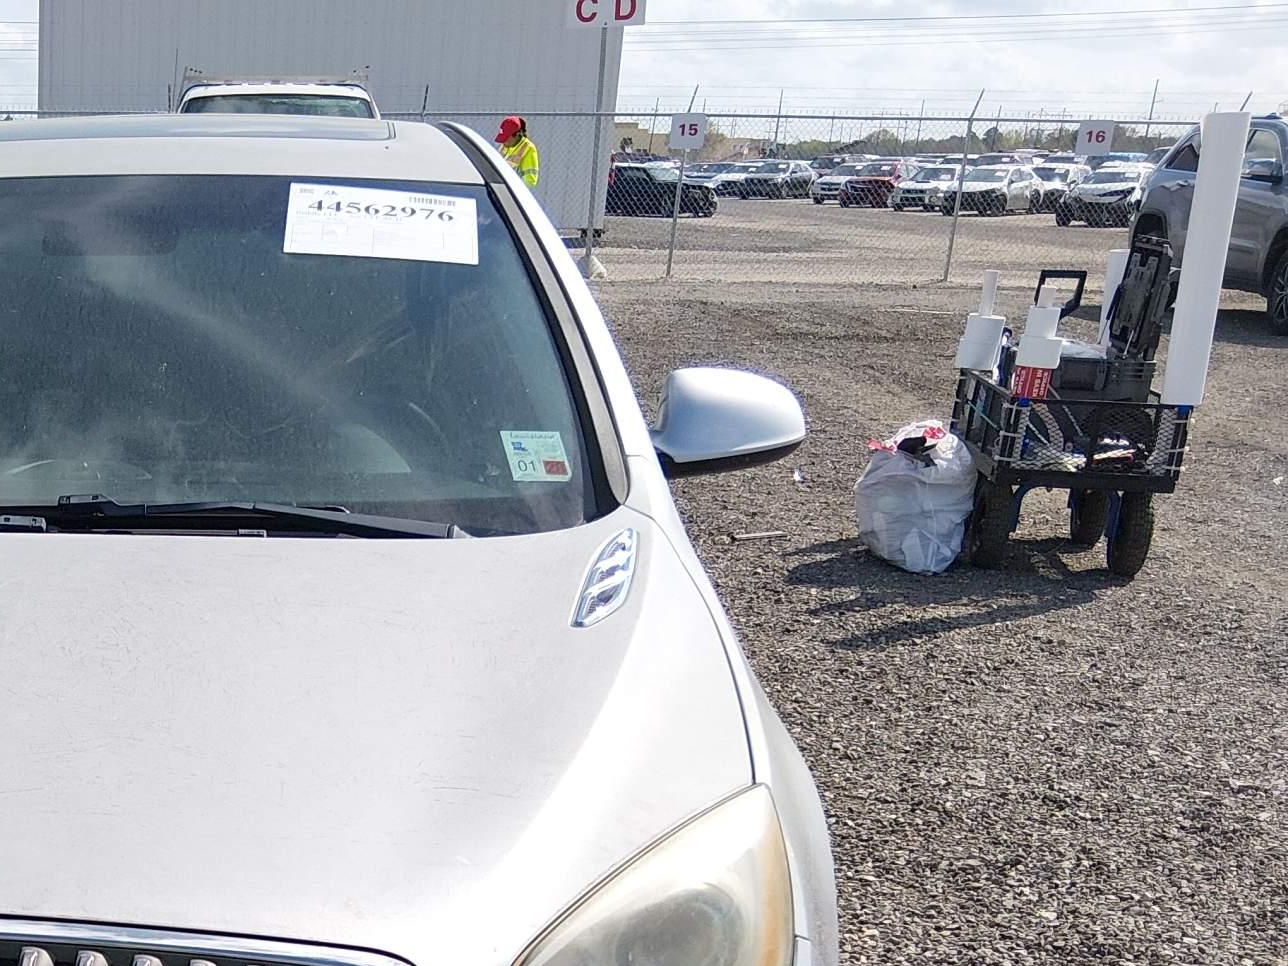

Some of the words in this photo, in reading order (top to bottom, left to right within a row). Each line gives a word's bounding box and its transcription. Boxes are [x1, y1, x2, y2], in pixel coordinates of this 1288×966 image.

[576, 0, 598, 23] C
[615, 0, 637, 20] D
[679, 123, 698, 136] 15
[1086, 130, 1106, 143] 16
[308, 199, 454, 222] 44562976
[517, 460, 536, 472] 01
